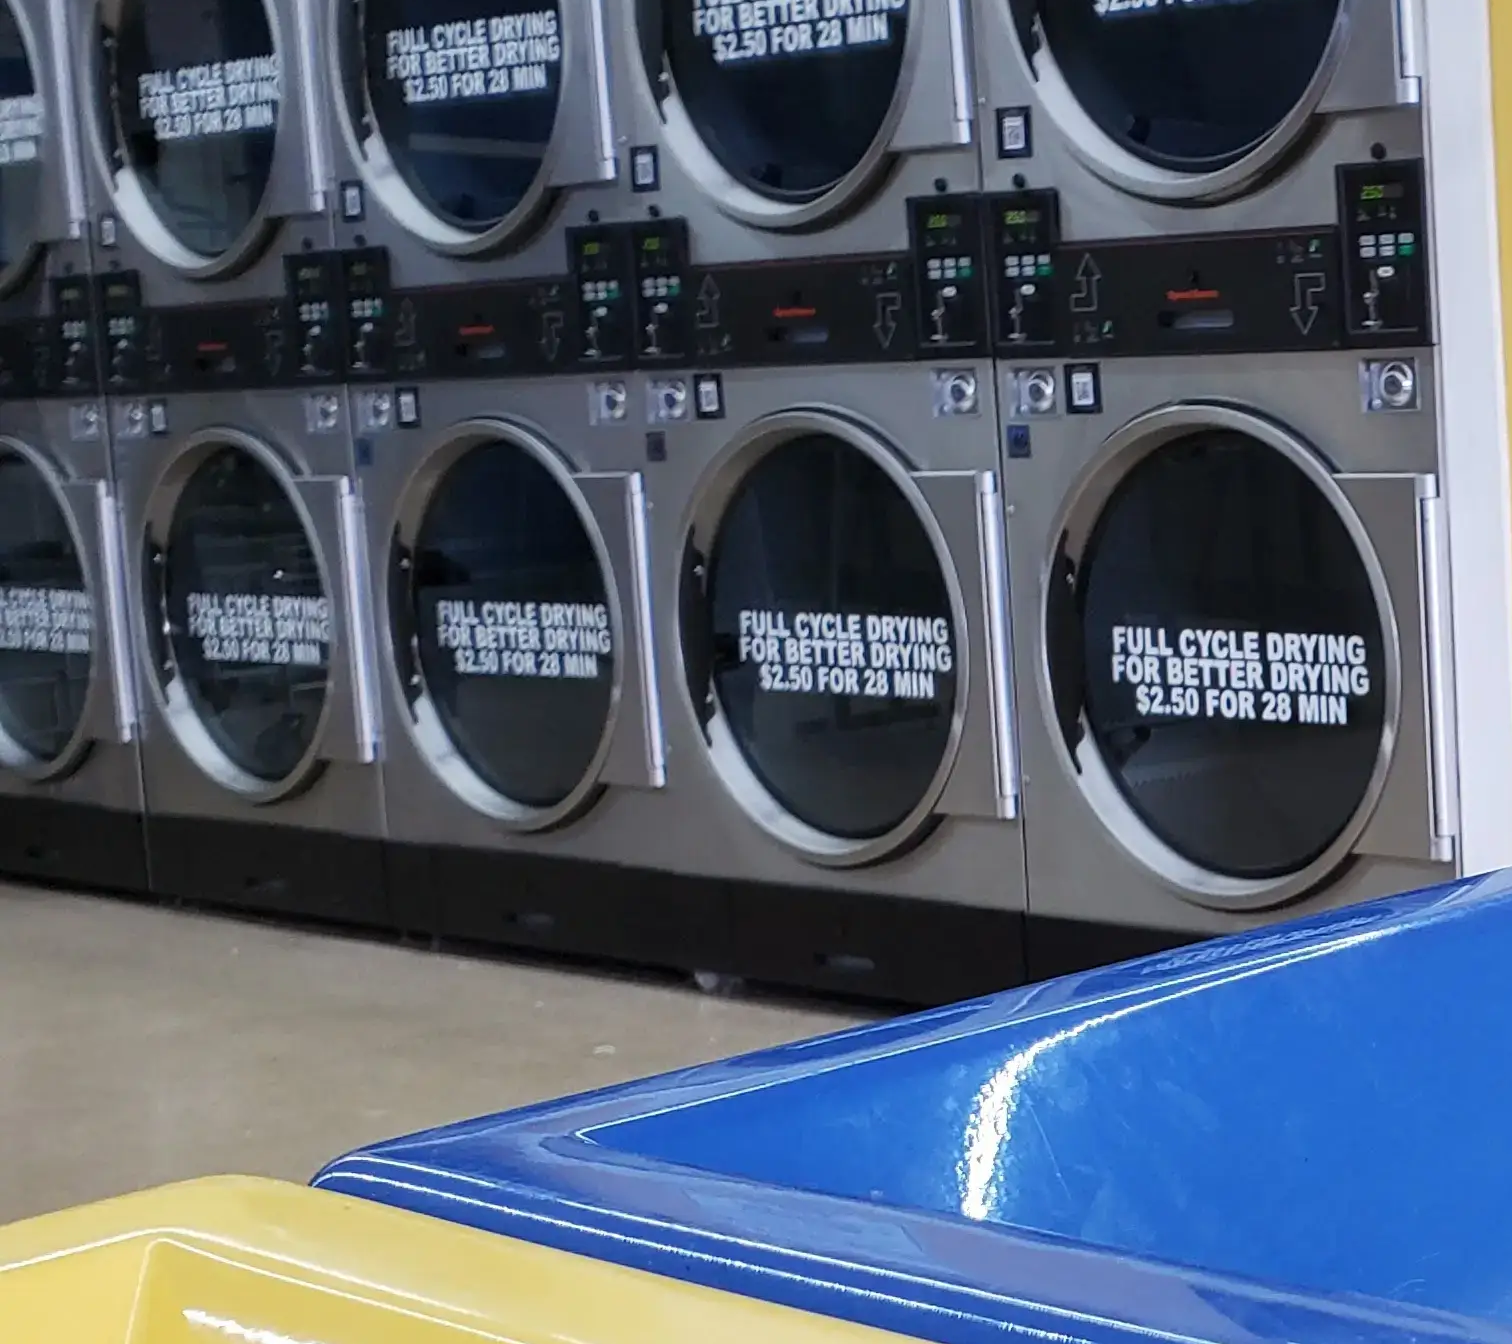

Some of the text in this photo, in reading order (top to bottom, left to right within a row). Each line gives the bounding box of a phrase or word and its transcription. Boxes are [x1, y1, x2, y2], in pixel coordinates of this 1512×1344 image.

[387, 9, 557, 56] FULL CYCLE DRYING
[692, 7, 734, 36] FOR
[712, 12, 889, 64] $2.50 FOR 28 MIN
[387, 36, 560, 80] FOR BETTER DRYING
[451, 71, 485, 98] FOR
[512, 64, 547, 91] MIN
[437, 600, 607, 628] FULL CYCLE DRYING
[739, 609, 949, 644] FULL CYCLE DRYING
[437, 625, 611, 654] FOR BETTER DRYING
[739, 636, 952, 672] FOR BETTER DRYING
[1113, 626, 1366, 664] FULL CYCLE DRYING
[502, 650, 537, 675] FOR
[563, 653, 598, 678] MIN
[759, 662, 934, 699] $2.50 FOR 28 MIN
[1113, 654, 1370, 696] FOR BETTER DRYING
[1136, 684, 1347, 725] $2.50 FOR 28 MIN
